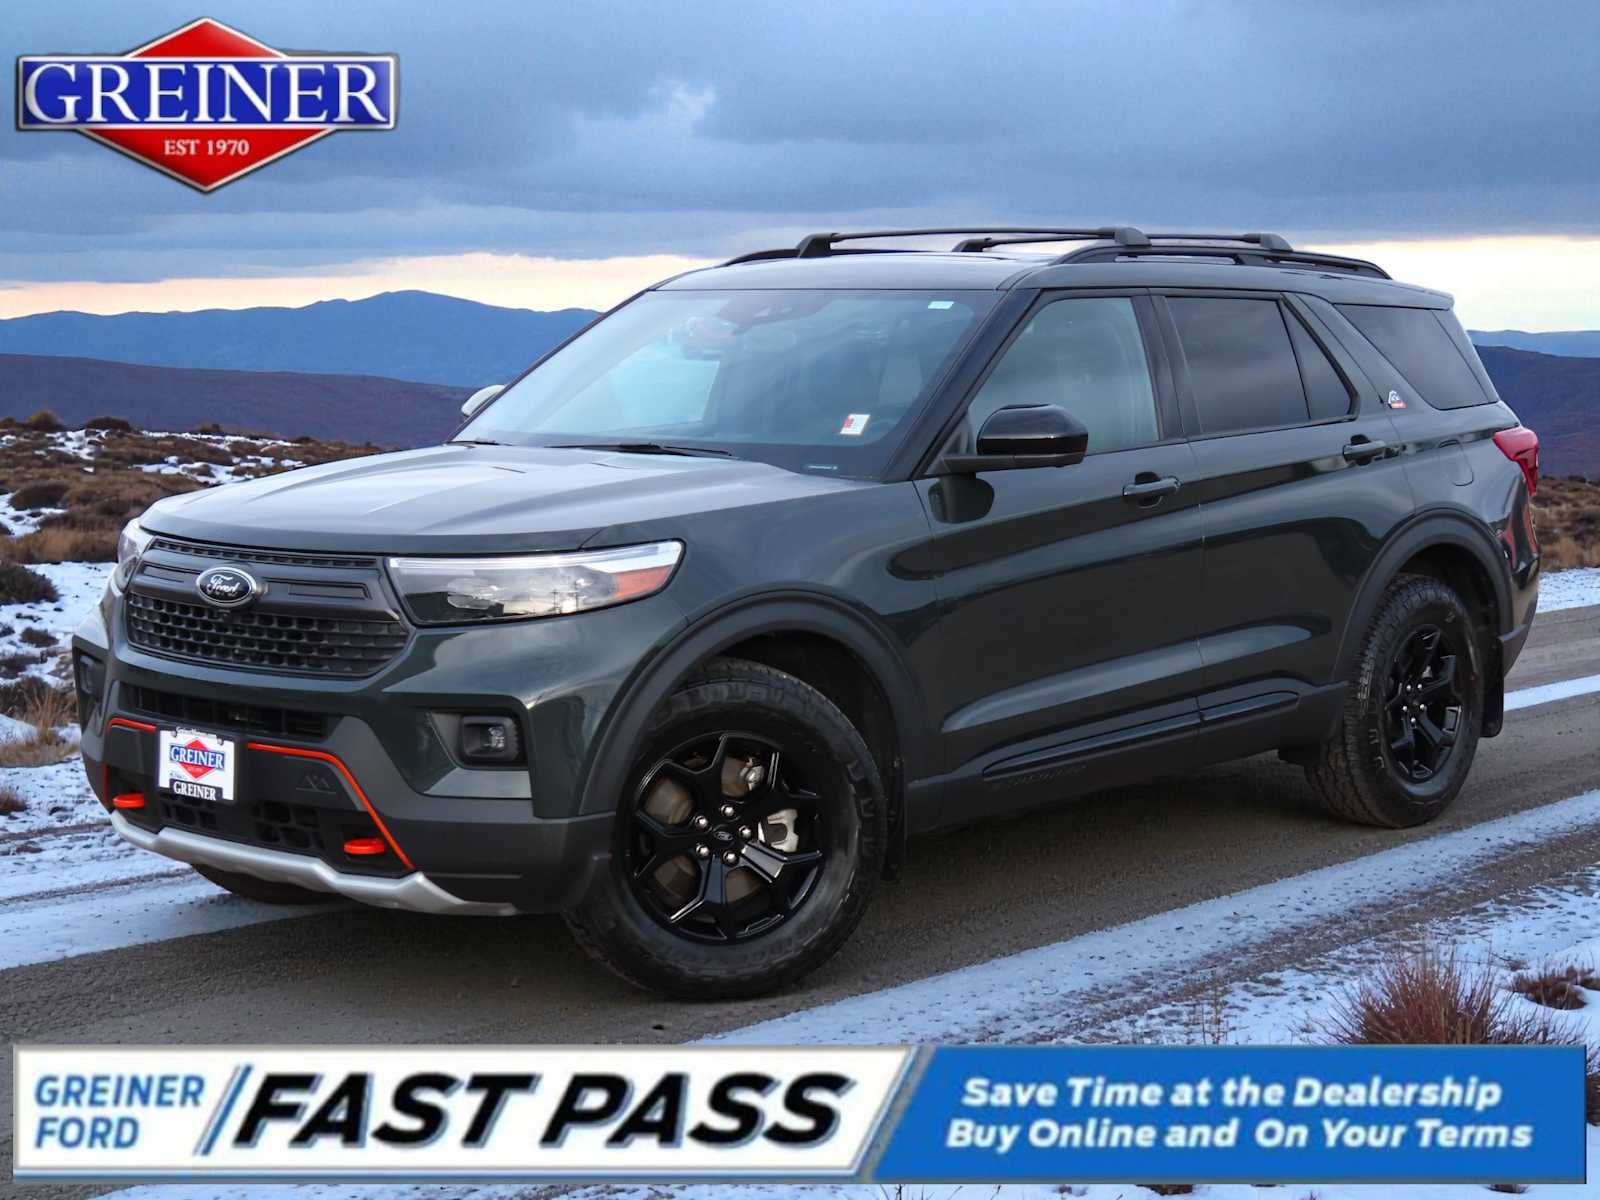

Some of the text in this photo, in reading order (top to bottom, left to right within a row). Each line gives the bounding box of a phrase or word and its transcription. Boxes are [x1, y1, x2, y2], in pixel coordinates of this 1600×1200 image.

[206, 574, 241, 597] Ford
[170, 746, 224, 769] GREINER
[173, 781, 217, 801] GREINER
